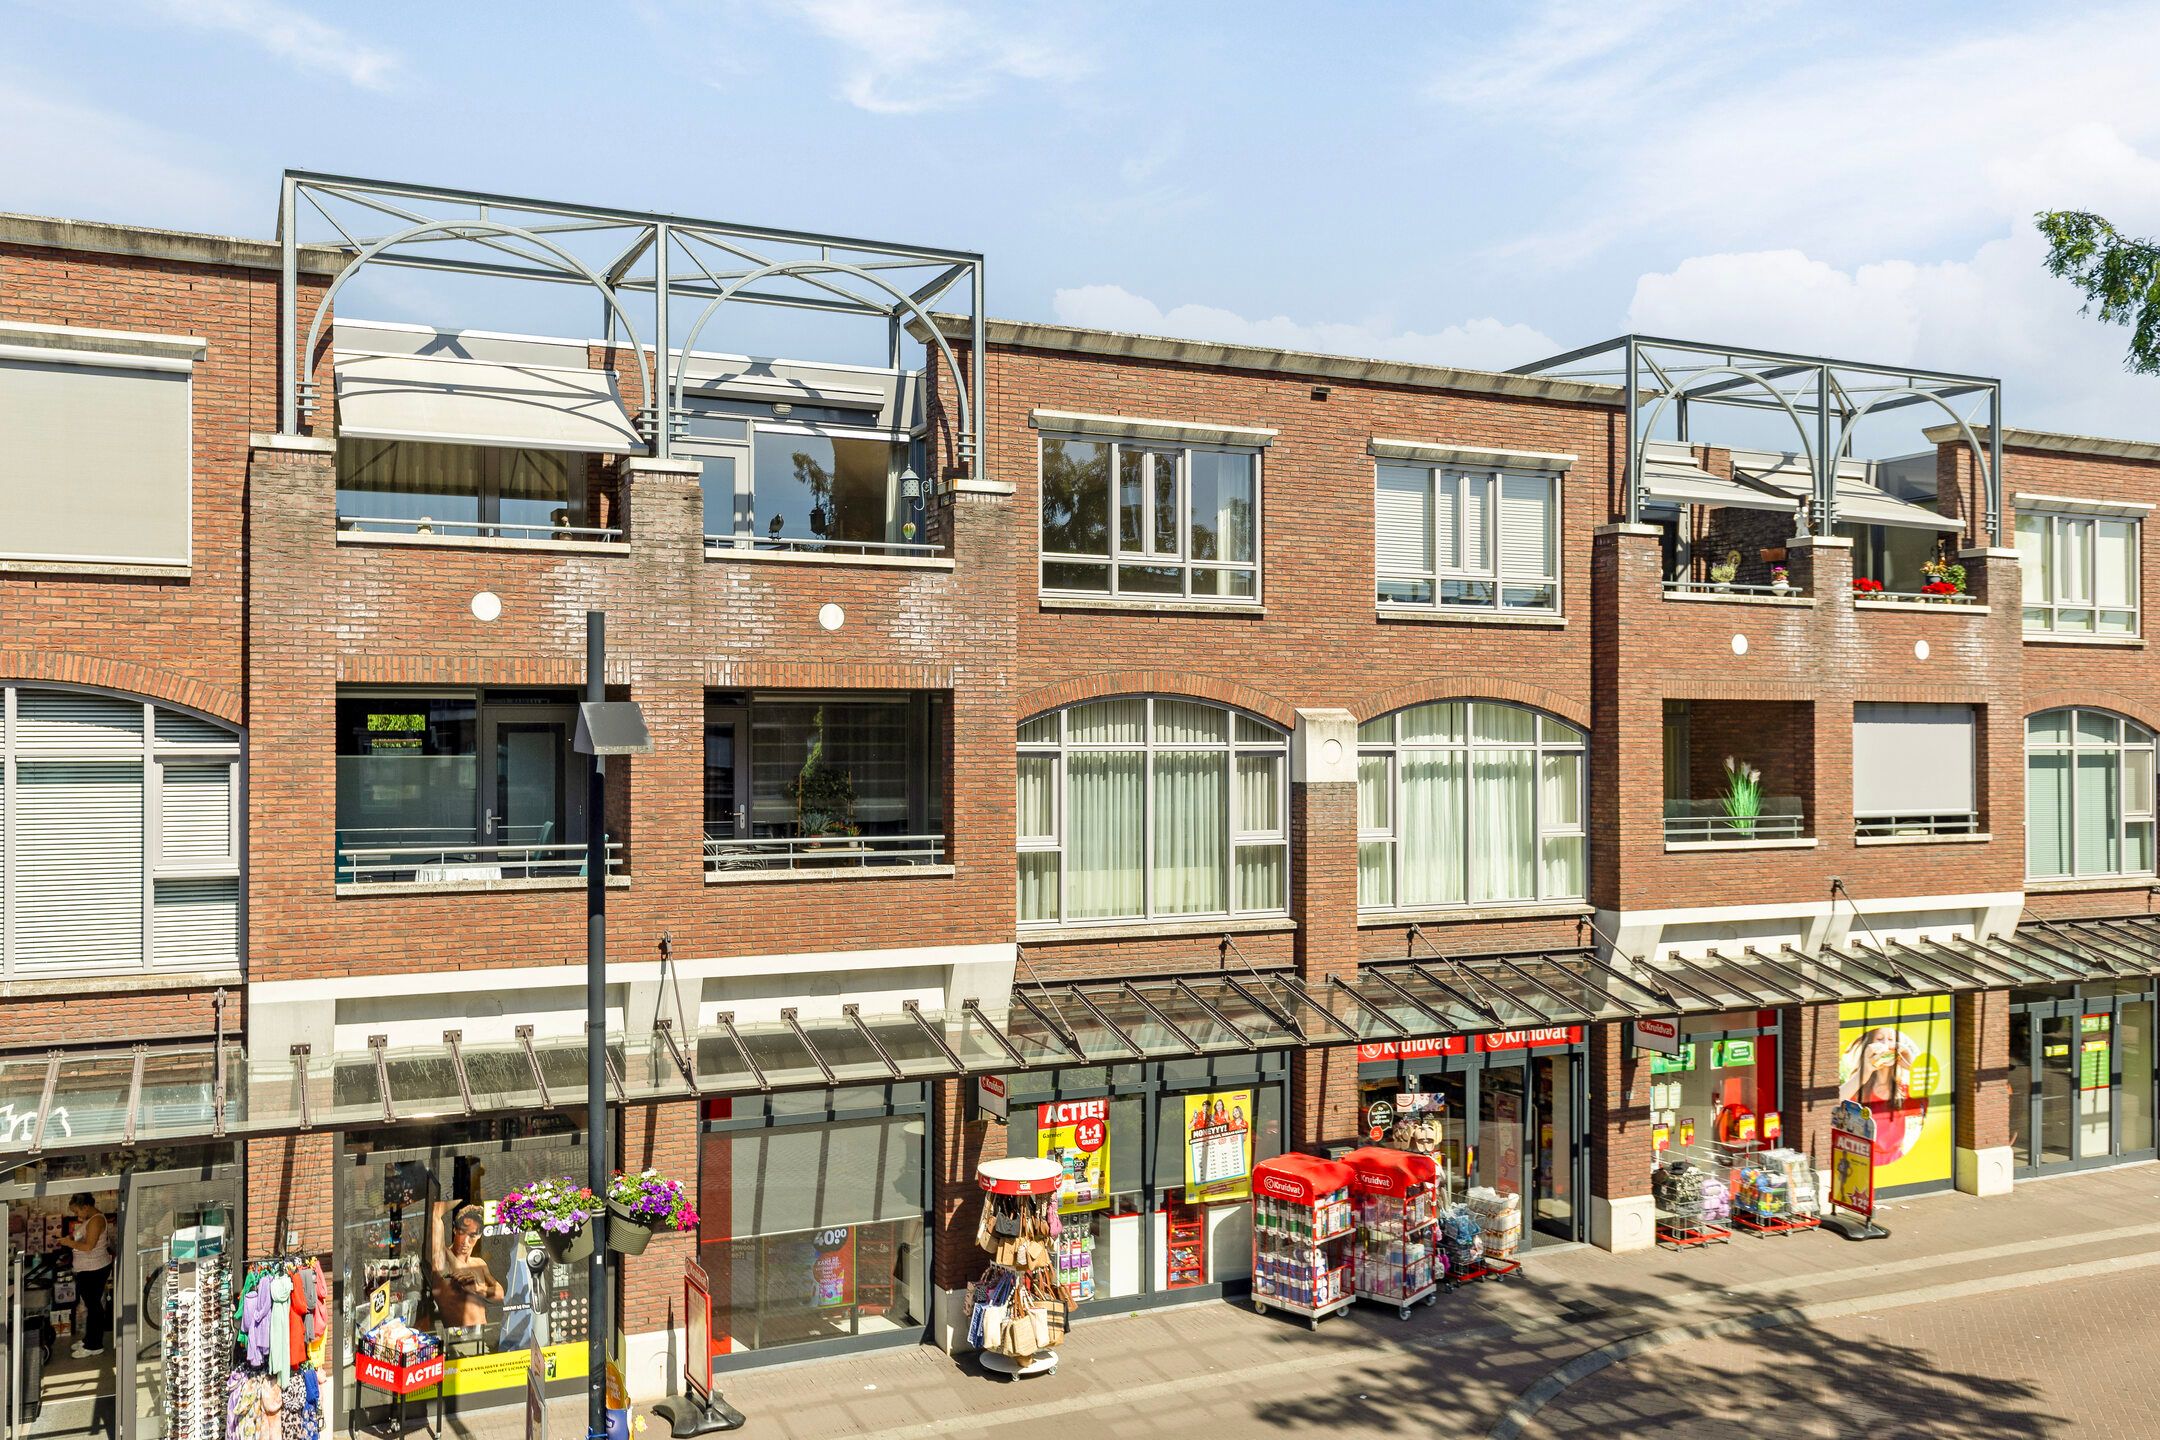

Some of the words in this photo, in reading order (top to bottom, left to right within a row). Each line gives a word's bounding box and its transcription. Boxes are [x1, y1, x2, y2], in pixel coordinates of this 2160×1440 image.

[1646, 1021, 1673, 1036] Kruidvat
[986, 1078, 1004, 1095] Kruidvat
[1045, 1099, 1105, 1124] ACTIE!
[1079, 1124, 1101, 1140] 1+1
[1193, 1124, 1228, 1138] MONEYYY!
[1837, 1136, 1870, 1157] ACTIE!
[1274, 1181, 1301, 1195] Kruidvat
[1361, 1174, 1390, 1187] Kruidvat
[365, 1363, 395, 1384] ACTIE
[405, 1362, 443, 1386] ACTIE
